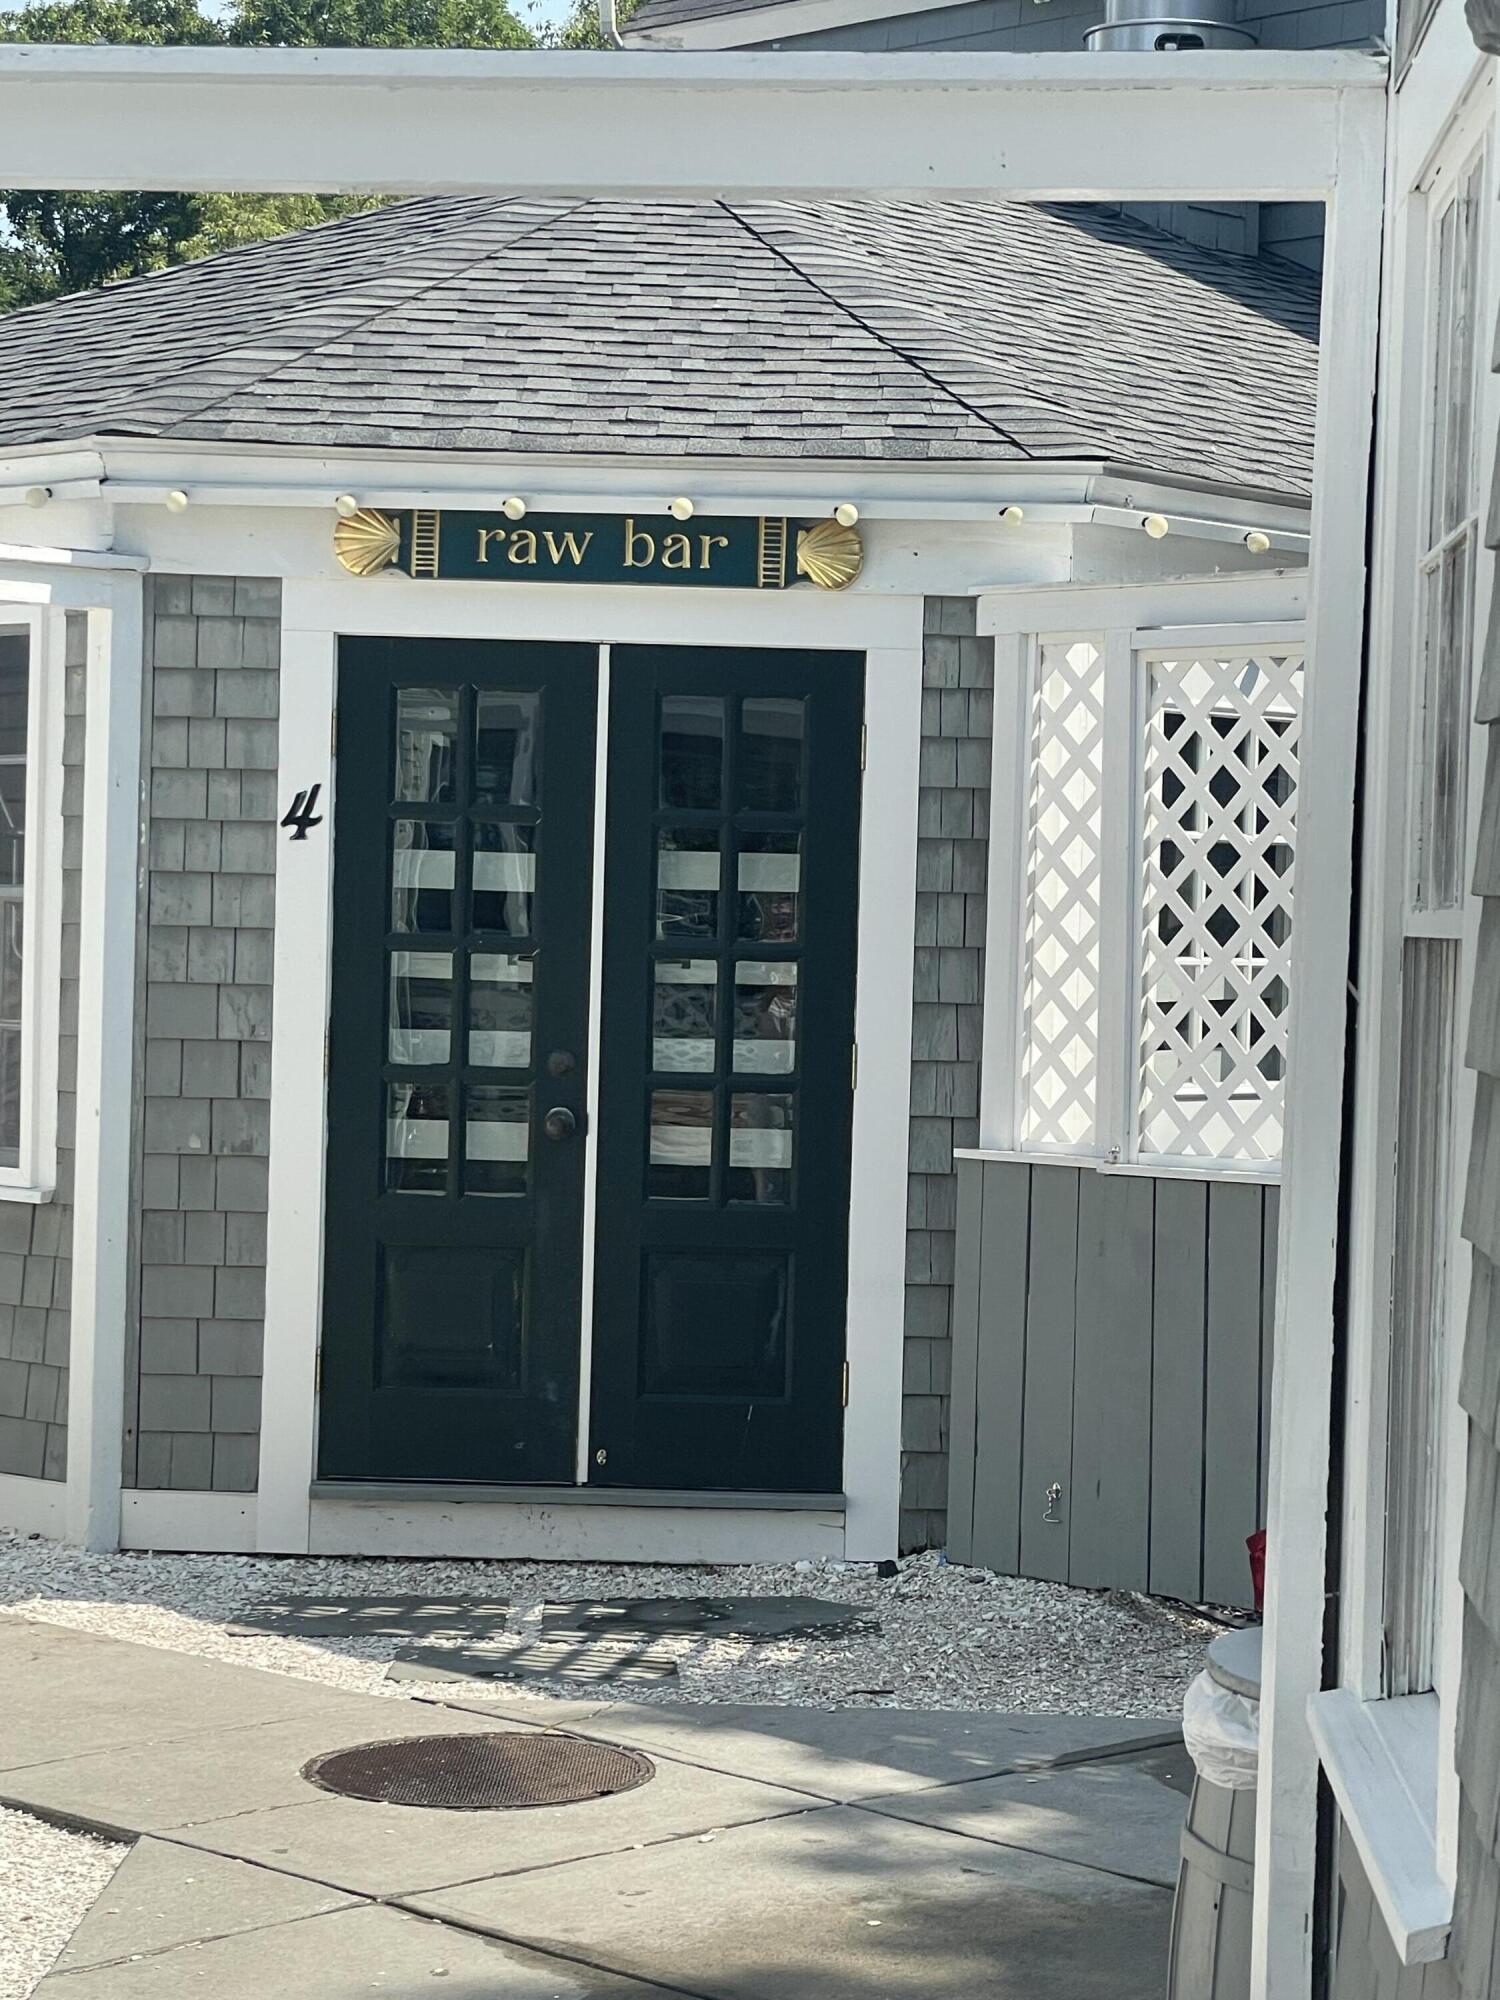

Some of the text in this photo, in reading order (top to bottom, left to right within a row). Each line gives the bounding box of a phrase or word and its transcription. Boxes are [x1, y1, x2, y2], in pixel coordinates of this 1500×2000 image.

[476, 518, 729, 569] raw bar
[280, 783, 323, 840] 4
